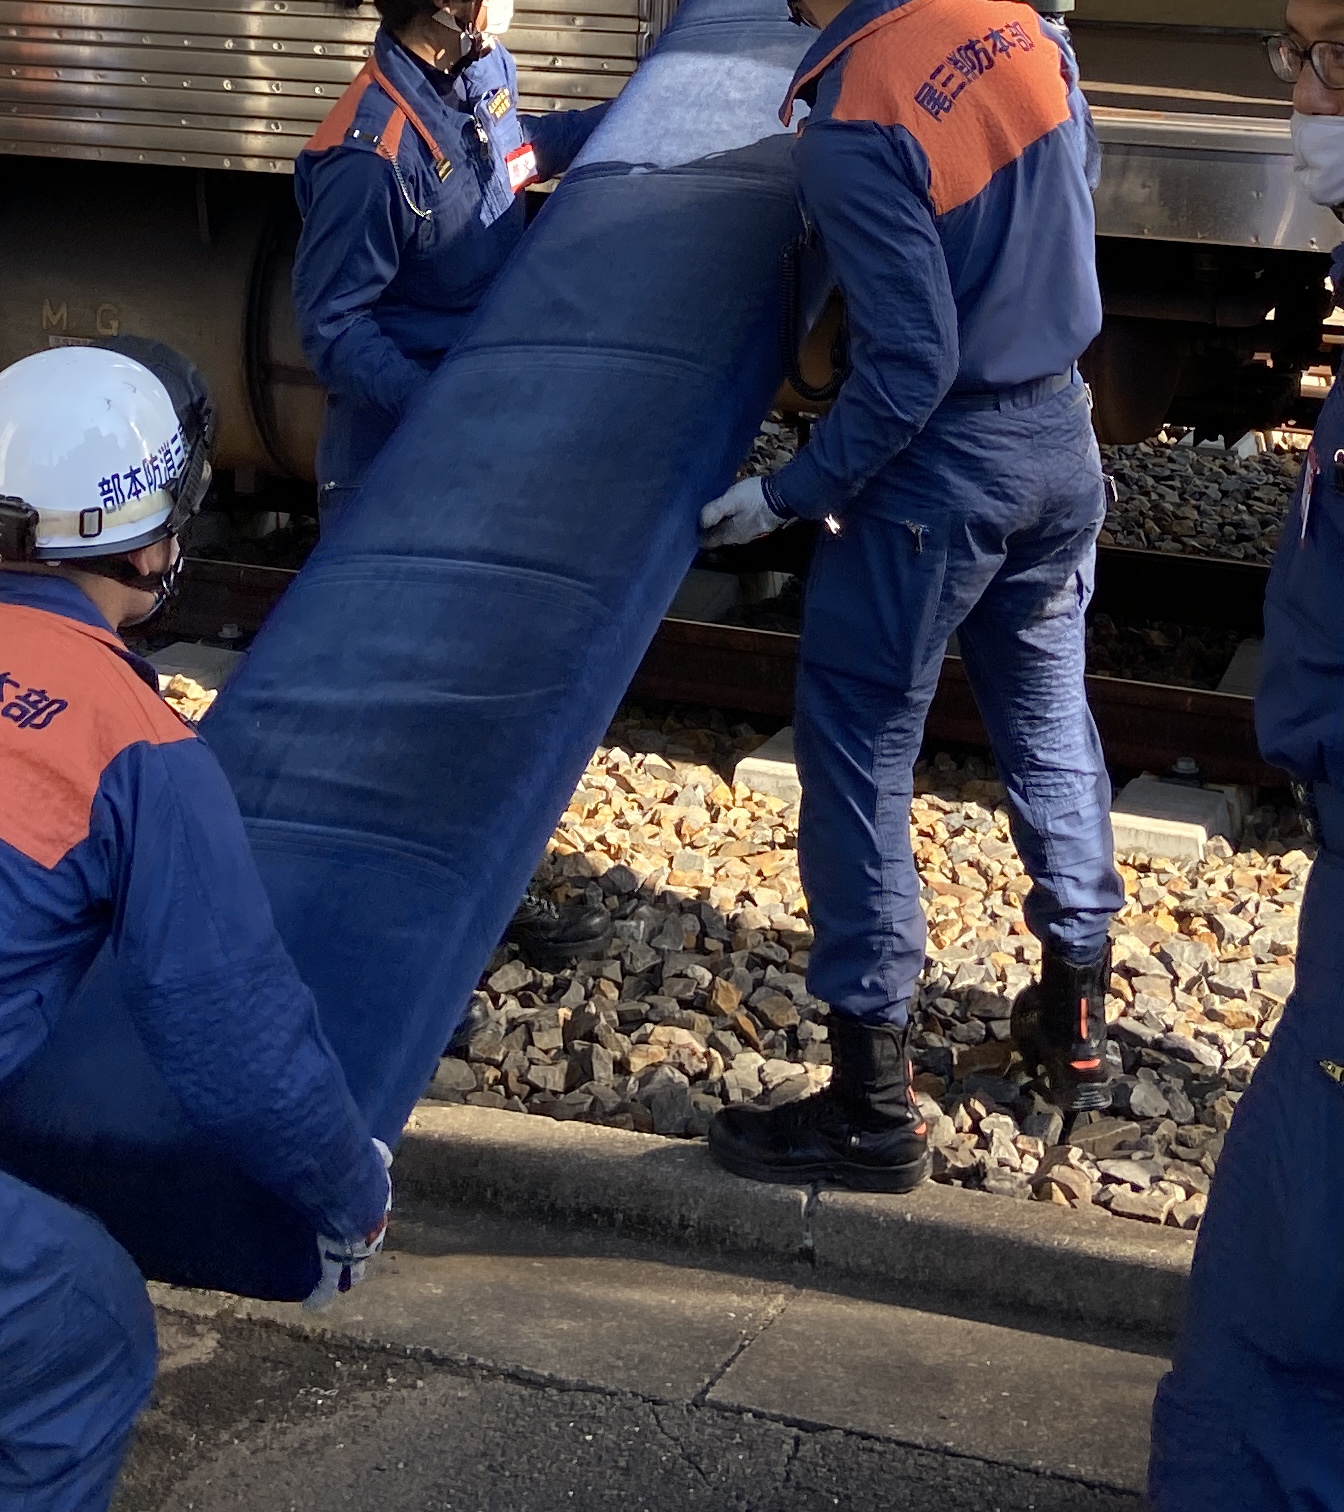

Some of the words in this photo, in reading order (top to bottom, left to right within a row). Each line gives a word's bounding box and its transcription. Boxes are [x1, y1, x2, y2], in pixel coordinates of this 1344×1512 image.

[97, 424, 186, 514] 部本防消三
